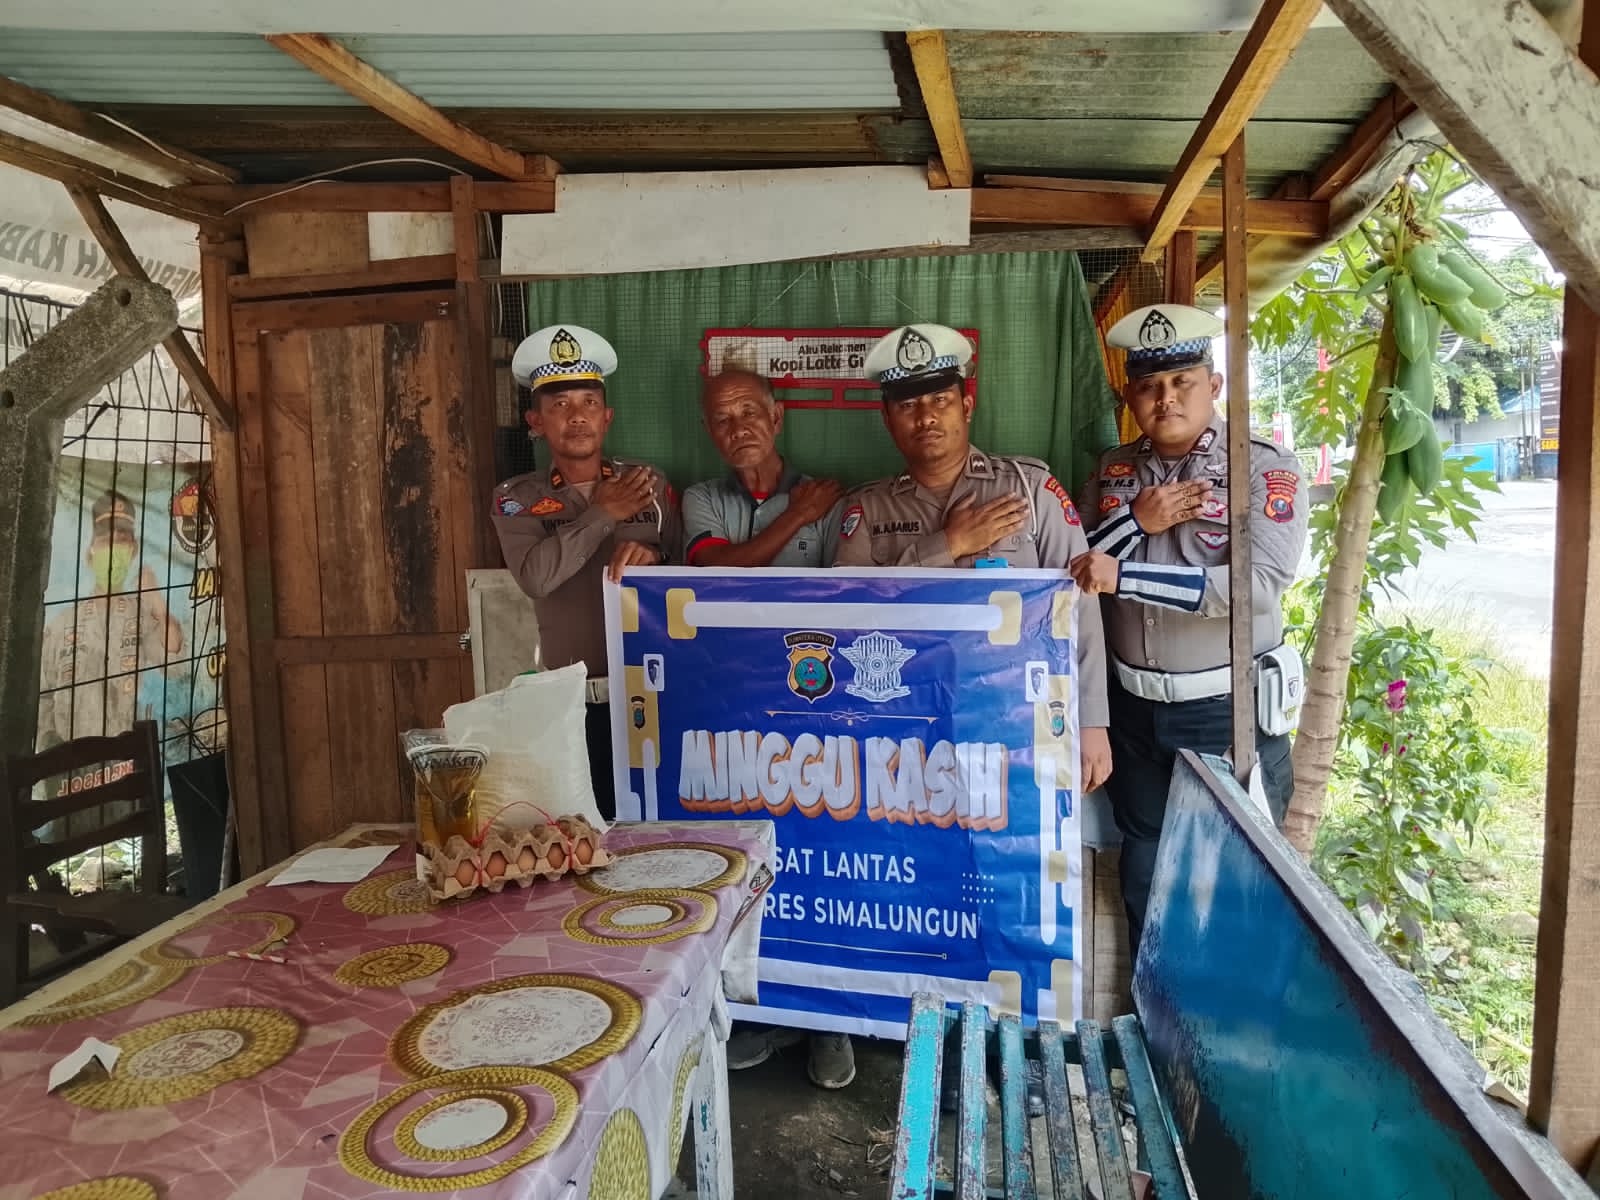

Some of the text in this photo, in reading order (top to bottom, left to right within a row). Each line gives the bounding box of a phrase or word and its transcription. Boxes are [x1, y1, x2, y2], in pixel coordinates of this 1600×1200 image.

[769, 356, 803, 373] Kopi
[679, 729, 1009, 833] MINGGU KASIH
[774, 847, 917, 884] SAT LANTAS
[813, 897, 978, 939] SIMALUNGUN
